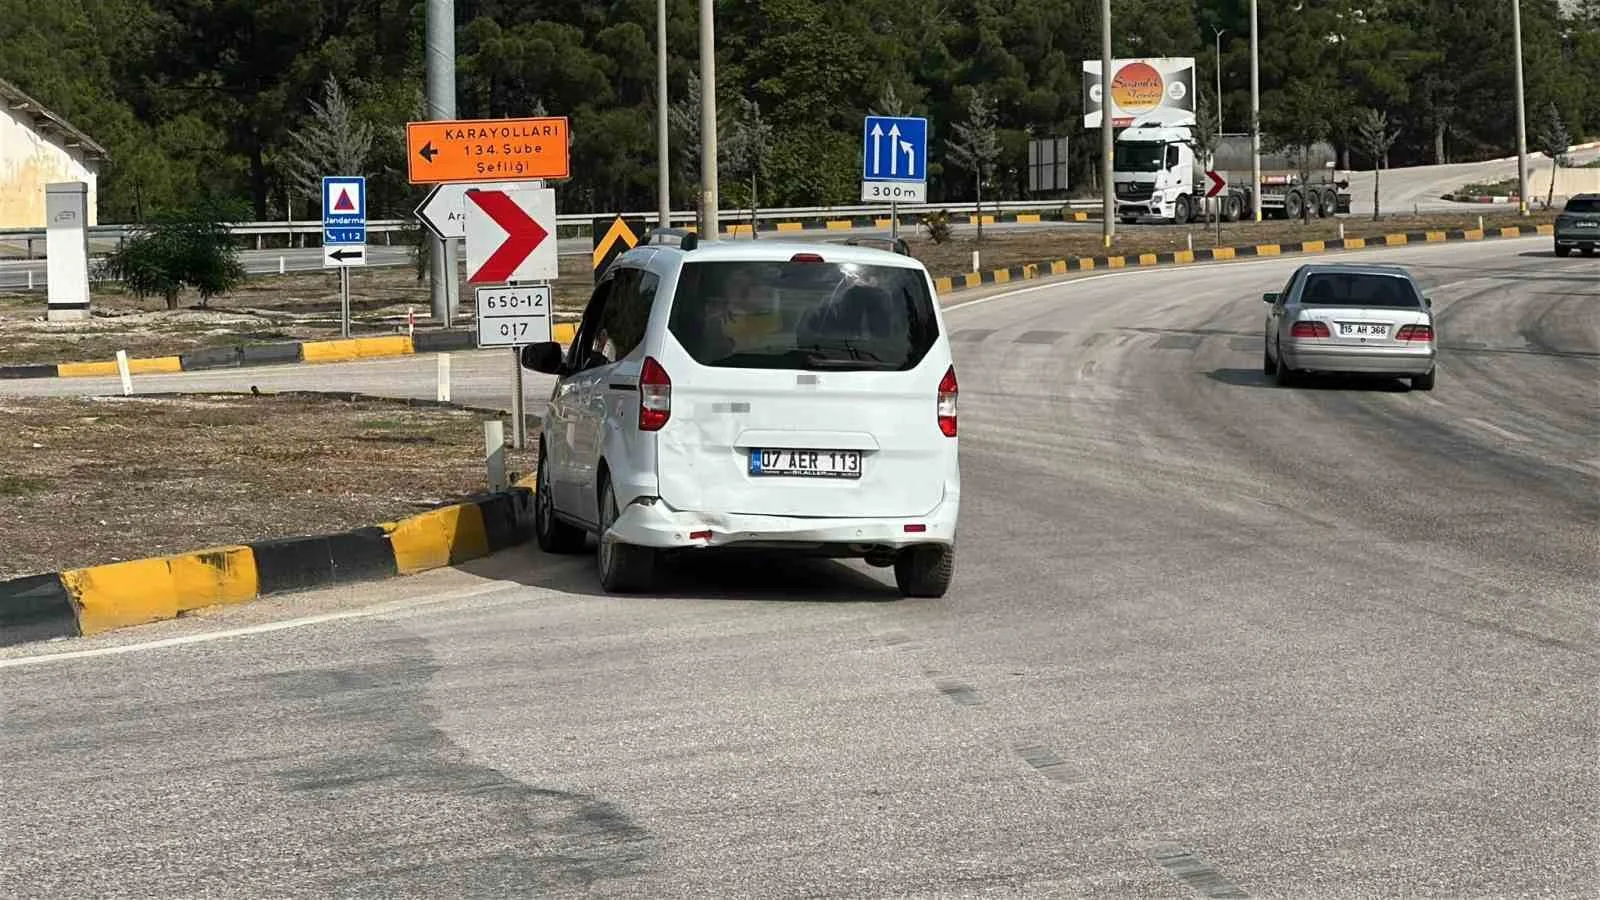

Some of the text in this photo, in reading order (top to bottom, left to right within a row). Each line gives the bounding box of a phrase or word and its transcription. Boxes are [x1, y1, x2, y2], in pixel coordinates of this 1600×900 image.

[445, 126, 558, 140] KARAYOLLARI
[464, 143, 542, 156] 134. Şube
[872, 186, 916, 197] 300m
[325, 216, 365, 224] Jandarma
[342, 232, 361, 240] 112
[487, 294, 544, 309] 650-12
[500, 322, 529, 336] 017
[1357, 325, 1367, 334] AH
[762, 450, 858, 471] 07 AER 113
